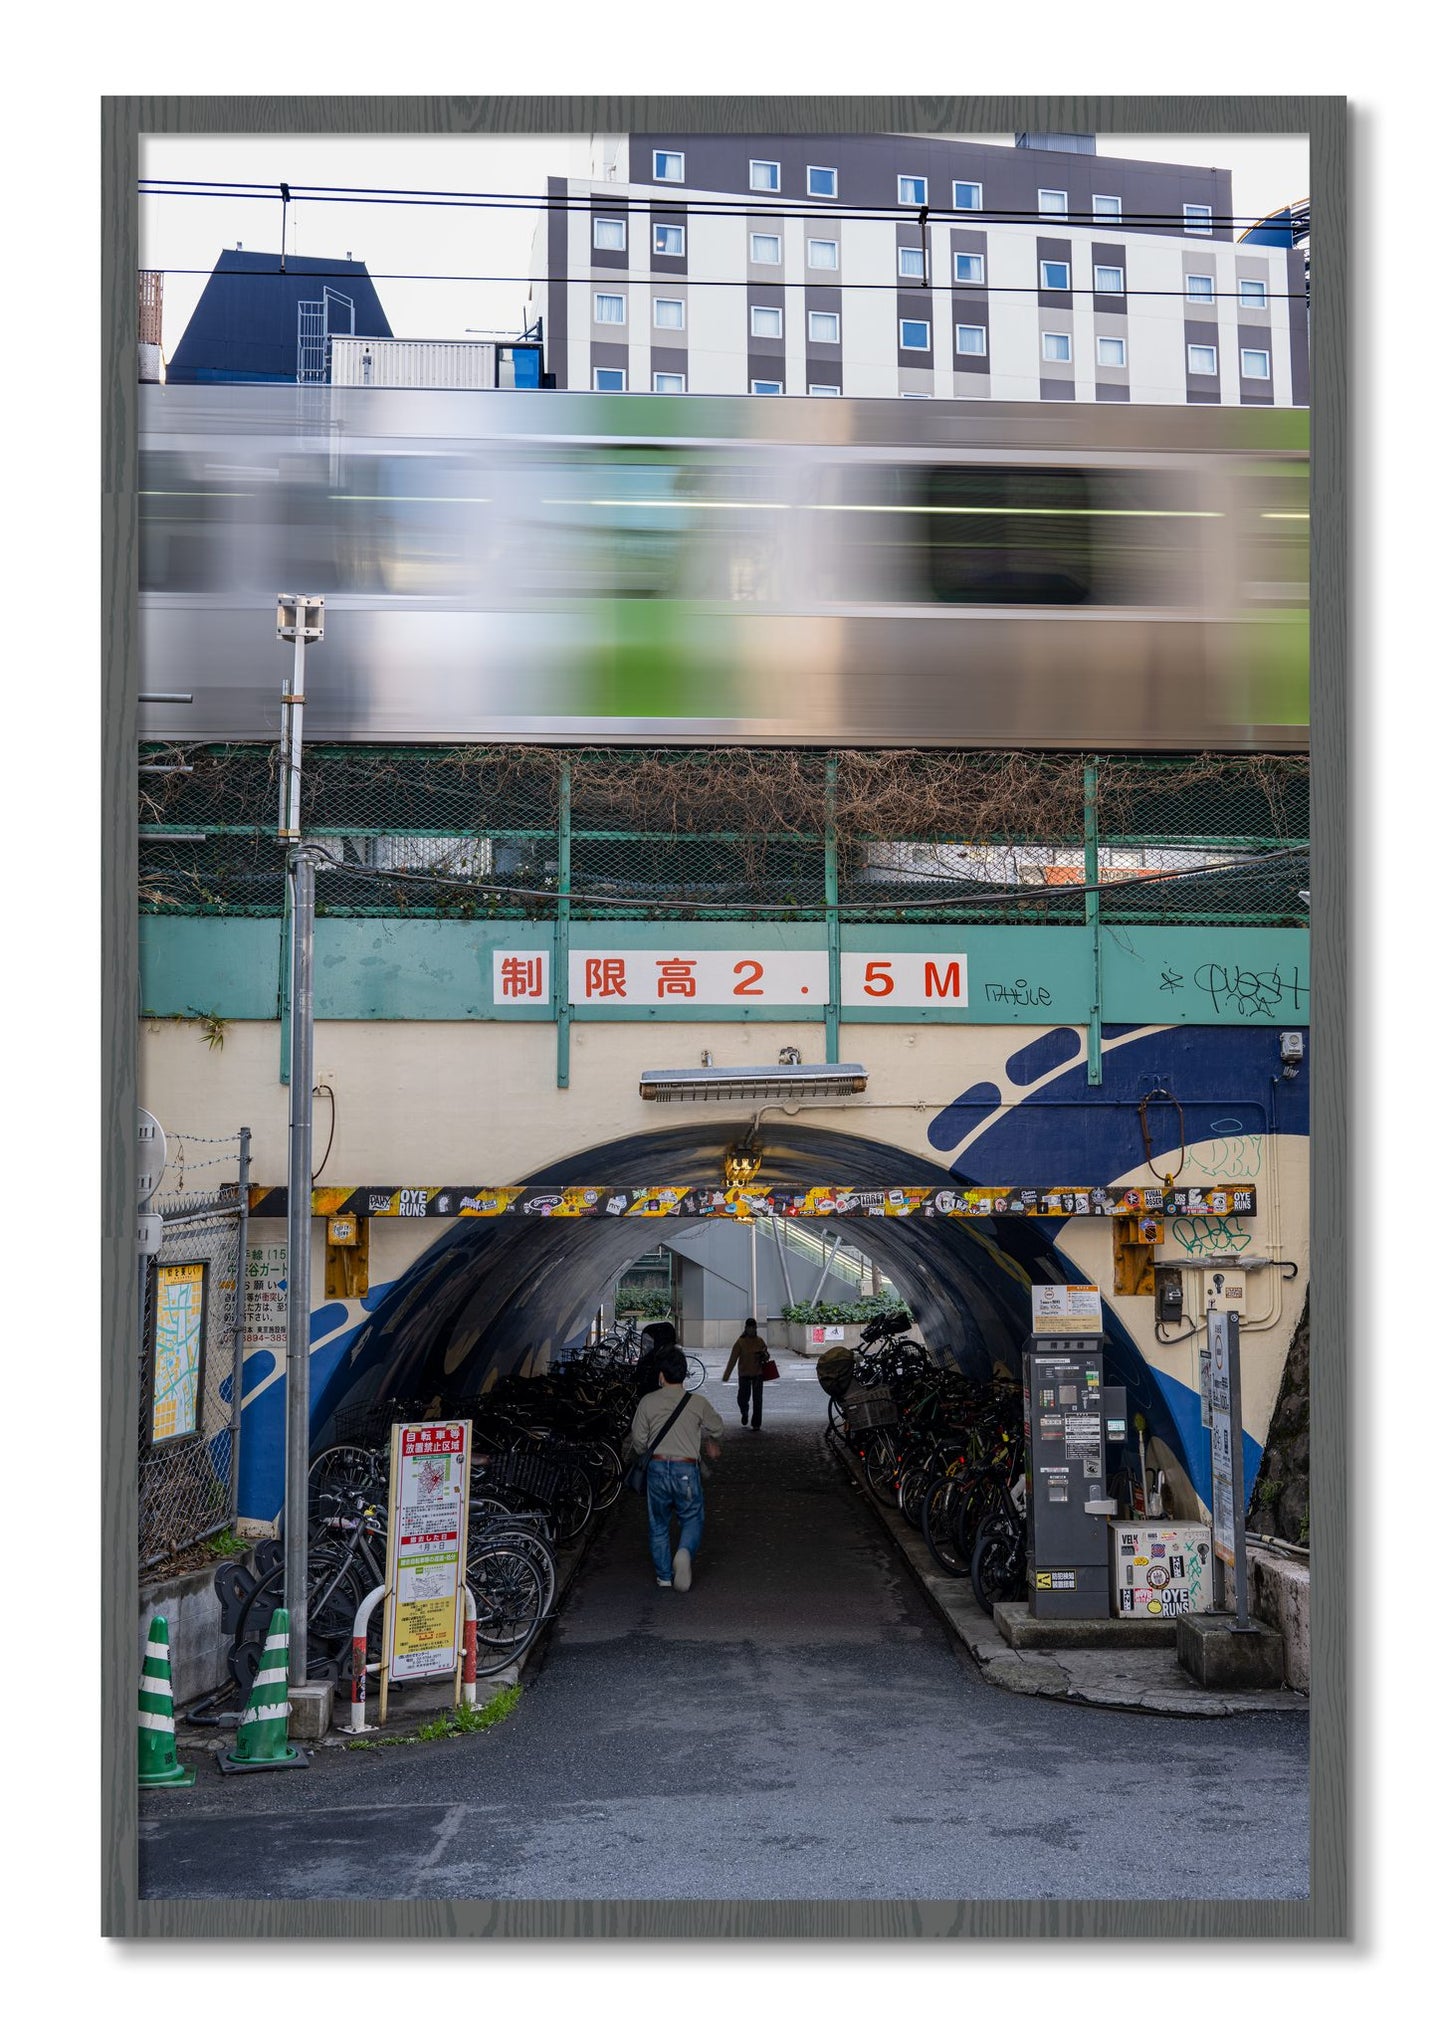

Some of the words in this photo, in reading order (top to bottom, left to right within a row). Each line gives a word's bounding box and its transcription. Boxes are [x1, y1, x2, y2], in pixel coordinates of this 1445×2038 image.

[400, 1189, 427, 1203] OYE
[1234, 1192, 1251, 1201] OYE
[399, 1203, 426, 1217] RUNS
[1234, 1200, 1251, 1210] RUNS
[405, 1440, 460, 1454] 放置禁止区域
[1162, 1589, 1188, 1603] OYE
[1163, 1602, 1189, 1617] RUNS
